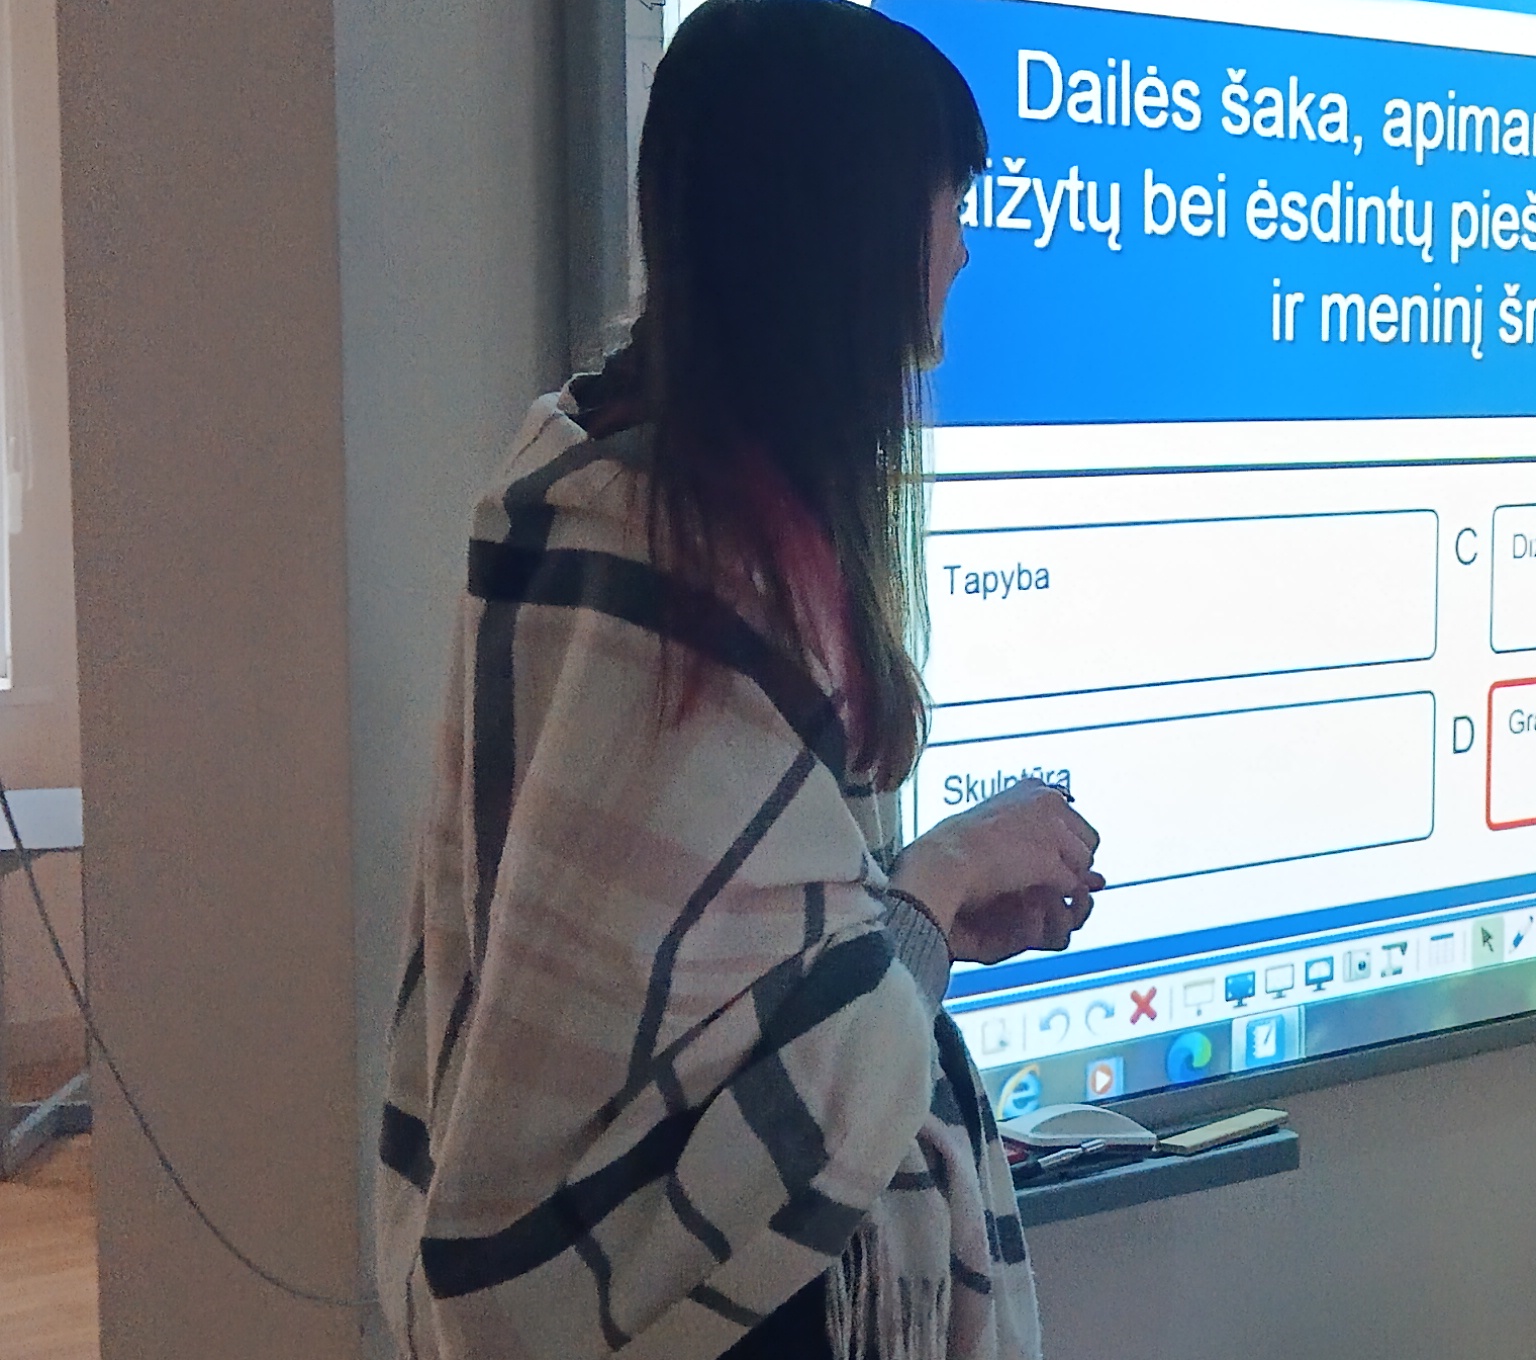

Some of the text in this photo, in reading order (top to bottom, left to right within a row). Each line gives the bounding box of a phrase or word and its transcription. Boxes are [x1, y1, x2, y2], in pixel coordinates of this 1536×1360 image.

[1017, 48, 1202, 132] Dailės
[1220, 67, 1364, 157] šaka,
[959, 156, 1122, 251] aižytų
[1144, 167, 1227, 239] bei
[1245, 178, 1434, 264] ėsdintų
[1272, 277, 1306, 342] ir
[1320, 281, 1484, 361] meninį
[1455, 526, 1479, 566] C
[943, 562, 1050, 601] Tapyba
[1452, 715, 1475, 755] D
